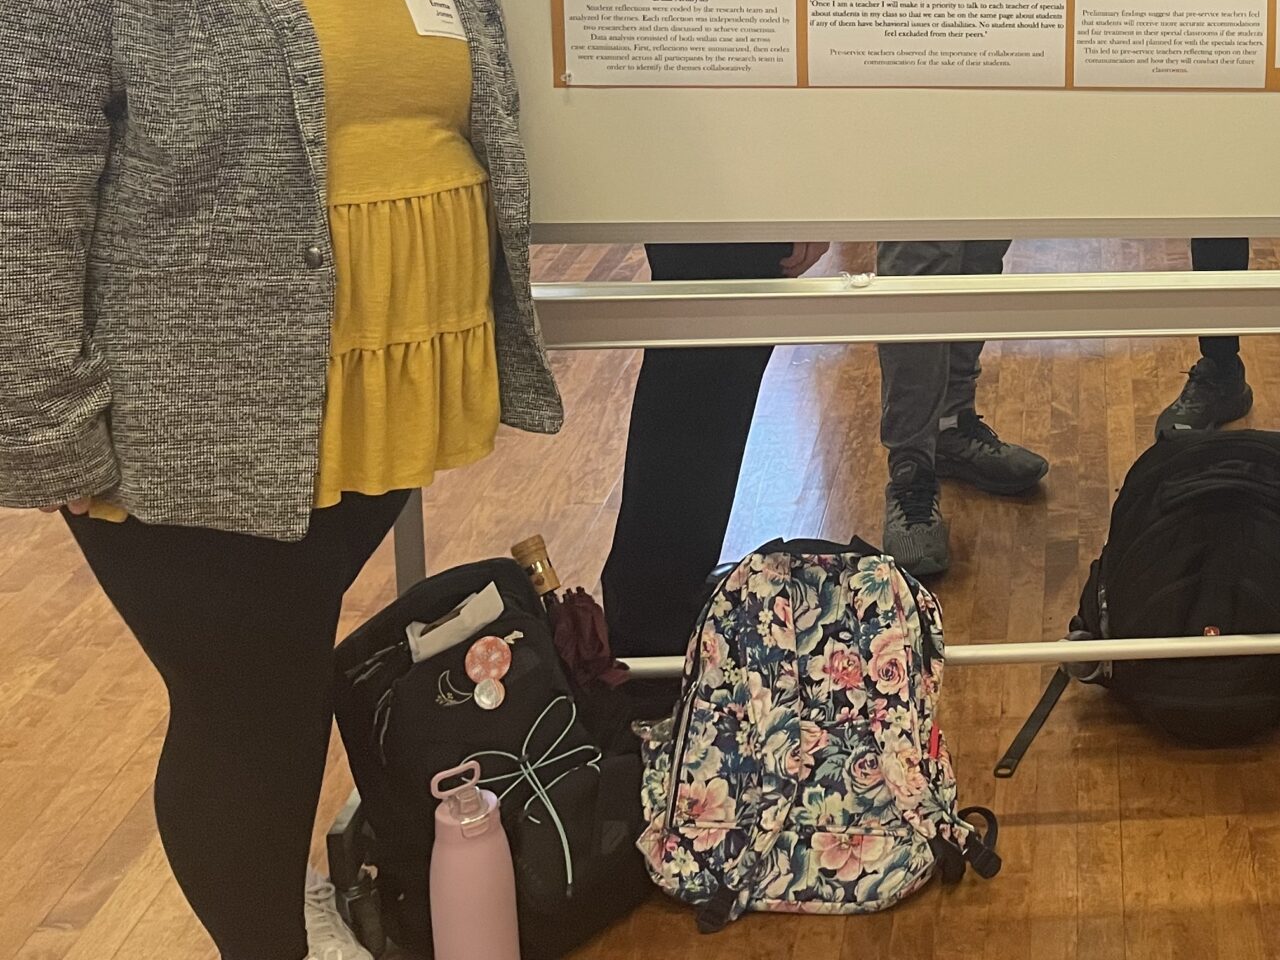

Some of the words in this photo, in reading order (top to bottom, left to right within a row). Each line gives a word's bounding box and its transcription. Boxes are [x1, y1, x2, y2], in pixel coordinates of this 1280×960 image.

[883, 29, 897, 37] feel
[897, 29, 929, 37] excluded
[929, 29, 947, 37] from
[964, 30, 988, 38] peers."
